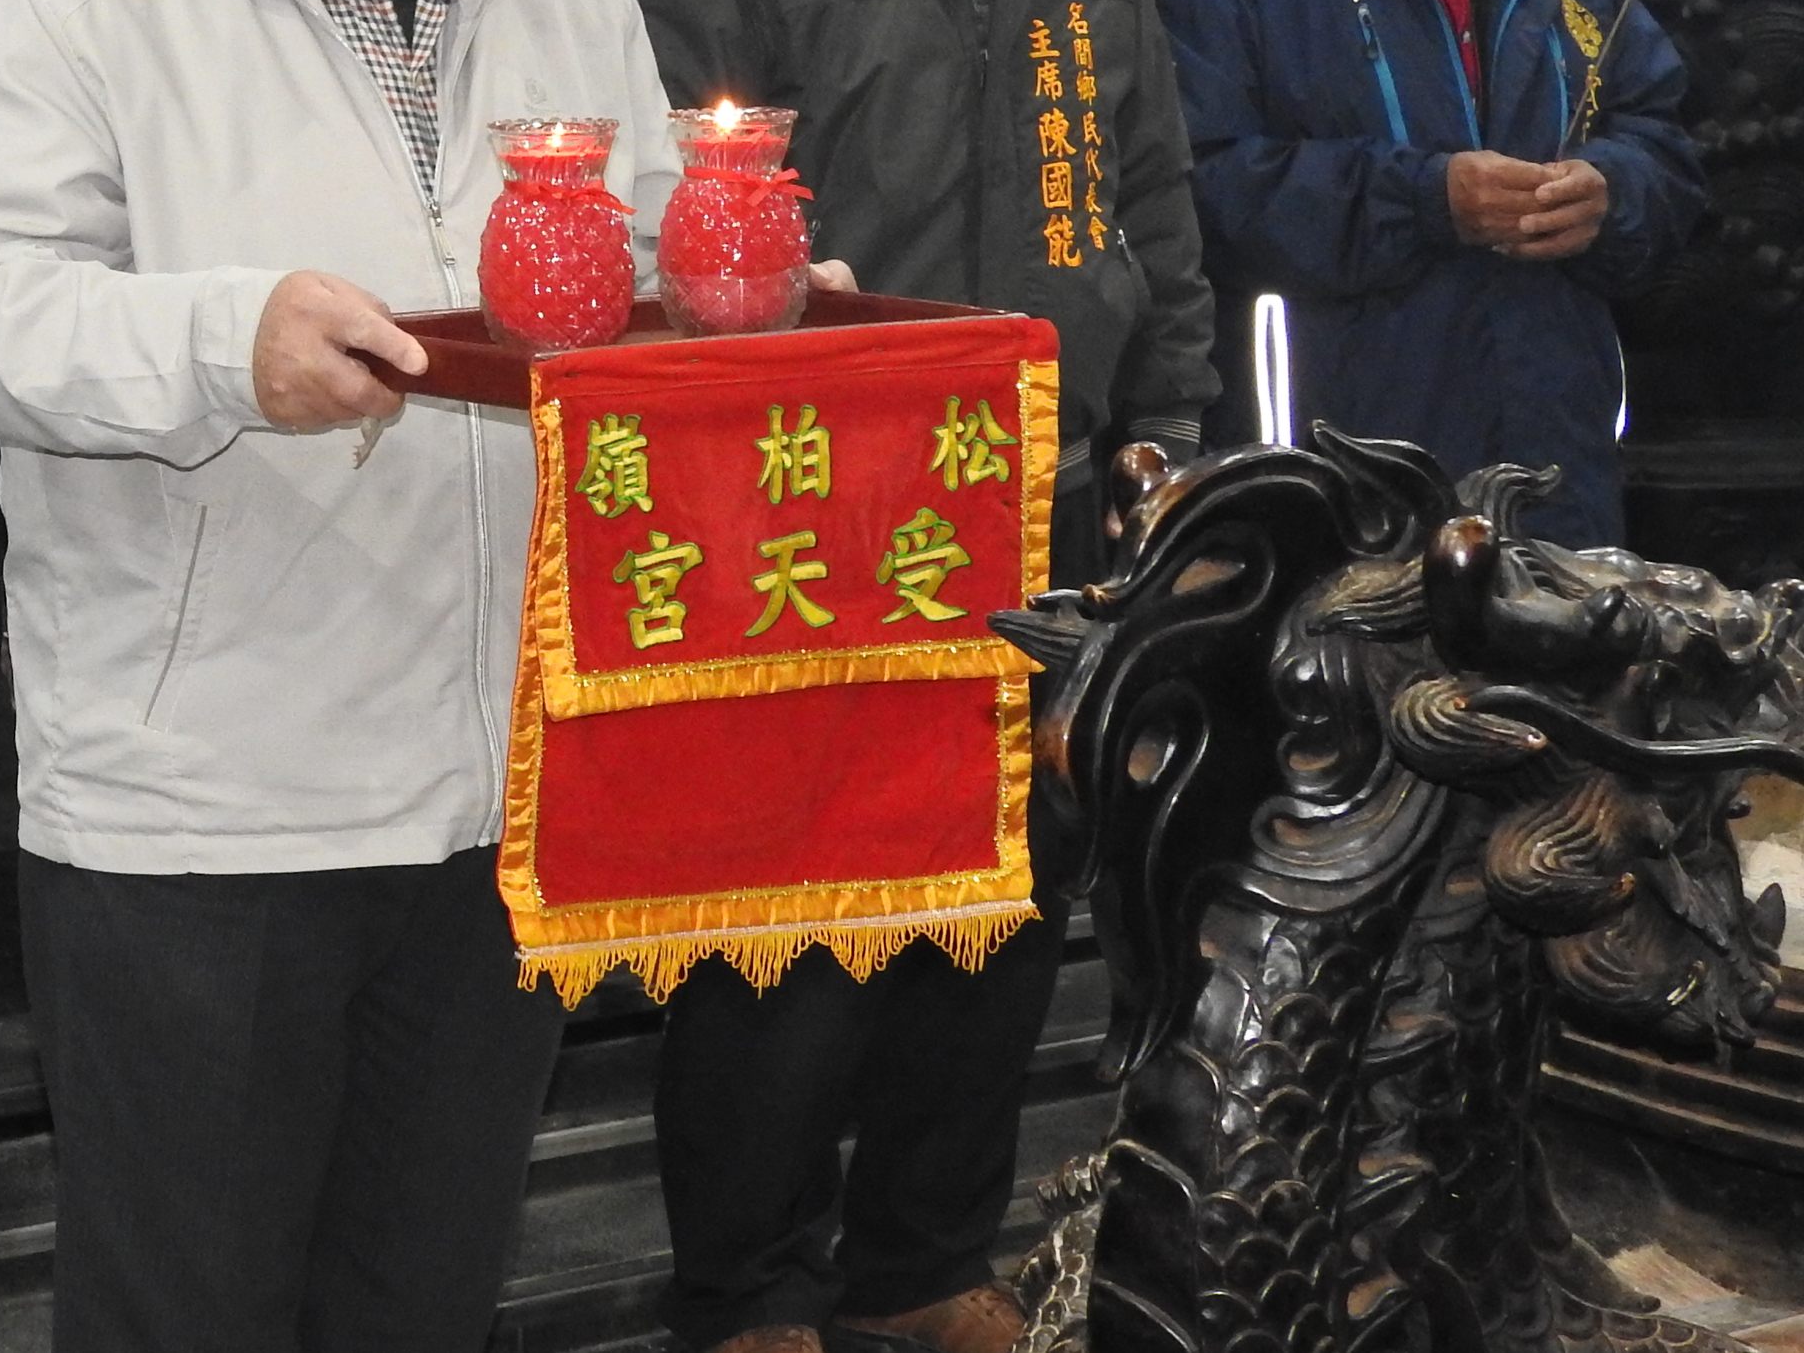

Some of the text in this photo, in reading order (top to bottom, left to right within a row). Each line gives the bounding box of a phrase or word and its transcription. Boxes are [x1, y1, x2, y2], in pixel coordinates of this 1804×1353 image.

[1067, 2, 1108, 251] 名間鄉民代表會
[574, 396, 1020, 518] 松柏嶺
[612, 508, 970, 649] 受天宮
